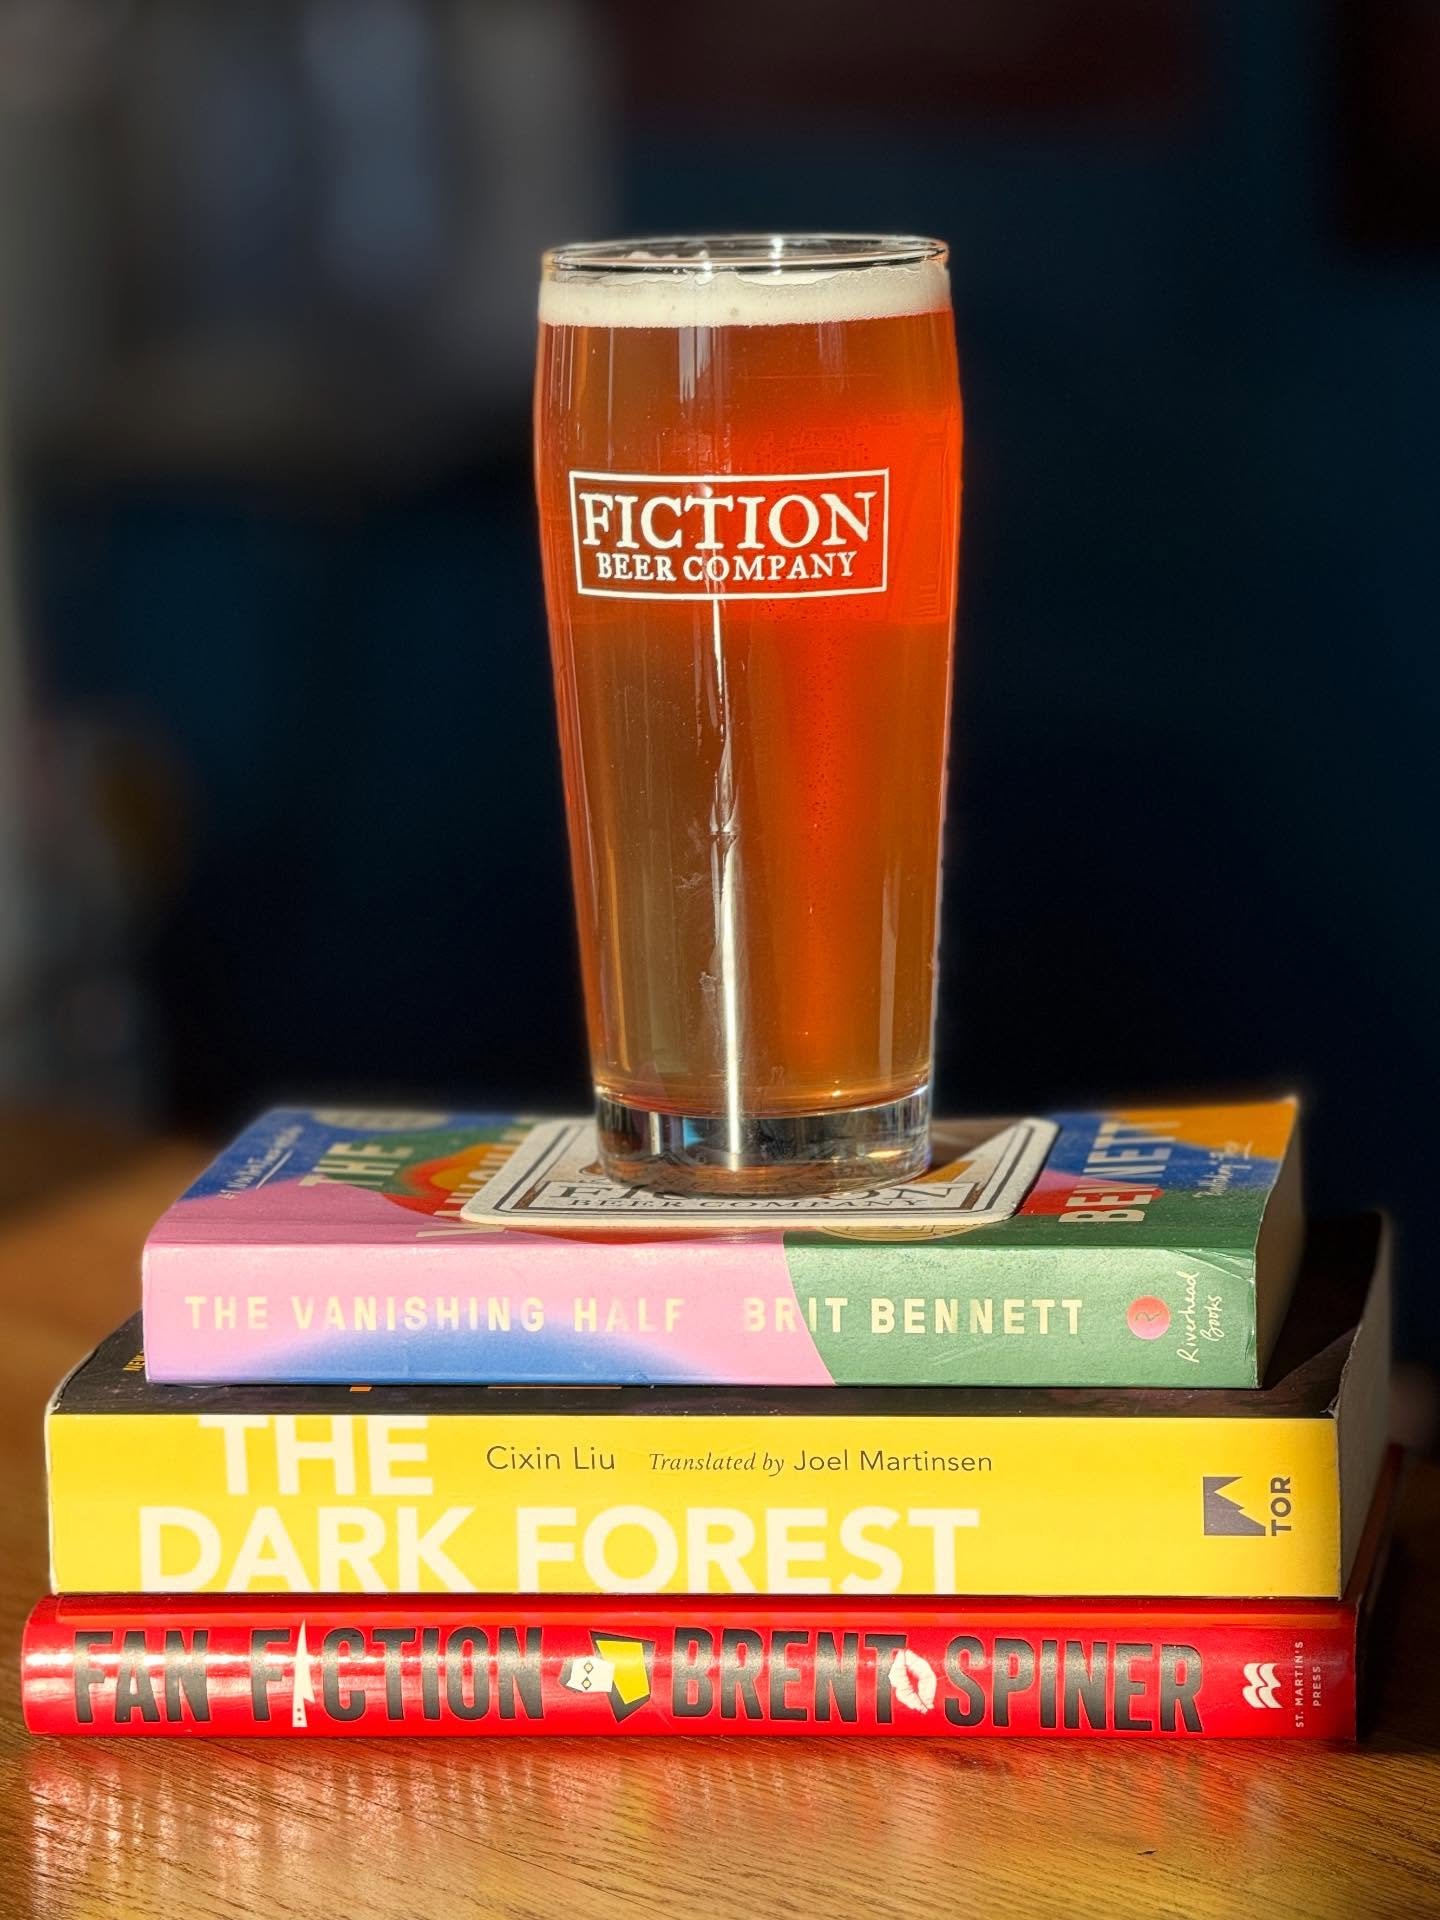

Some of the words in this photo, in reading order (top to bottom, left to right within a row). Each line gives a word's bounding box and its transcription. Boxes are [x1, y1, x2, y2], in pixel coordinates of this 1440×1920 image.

[579, 491, 877, 550] FICTION
[596, 552, 676, 582] BEER
[683, 551, 857, 582] COMPANY
[299, 1142, 414, 1188] THE
[569, 1199, 683, 1208] BEER
[700, 1199, 928, 1208] COMPANY
[184, 1296, 268, 1330] THE
[292, 1296, 544, 1332] VANISHING
[574, 1296, 686, 1332] HALF
[743, 1296, 848, 1333] BRIT
[871, 1297, 1082, 1335] BENNETT
[1176, 1270, 1200, 1363] Riverhead
[1200, 1294, 1225, 1341] Books
[199, 1415, 433, 1495] THE
[486, 1445, 560, 1470] Cixin
[574, 1447, 615, 1471] Liu
[649, 1452, 755, 1472] Translated
[763, 1453, 785, 1477] by
[794, 1449, 849, 1472] Joel
[861, 1450, 993, 1473] Martinsen
[1270, 1477, 1292, 1537] TOR
[139, 1506, 476, 1593] DARK
[517, 1505, 980, 1594] FOREST
[74, 1630, 211, 1725] FAN
[673, 1626, 908, 1725] BRENT
[944, 1635, 1203, 1733] SPINER
[1294, 1641, 1304, 1706] MARTIN'S
[1312, 1666, 1321, 1707] PRESS
[1295, 1711, 1305, 1728] ST.
